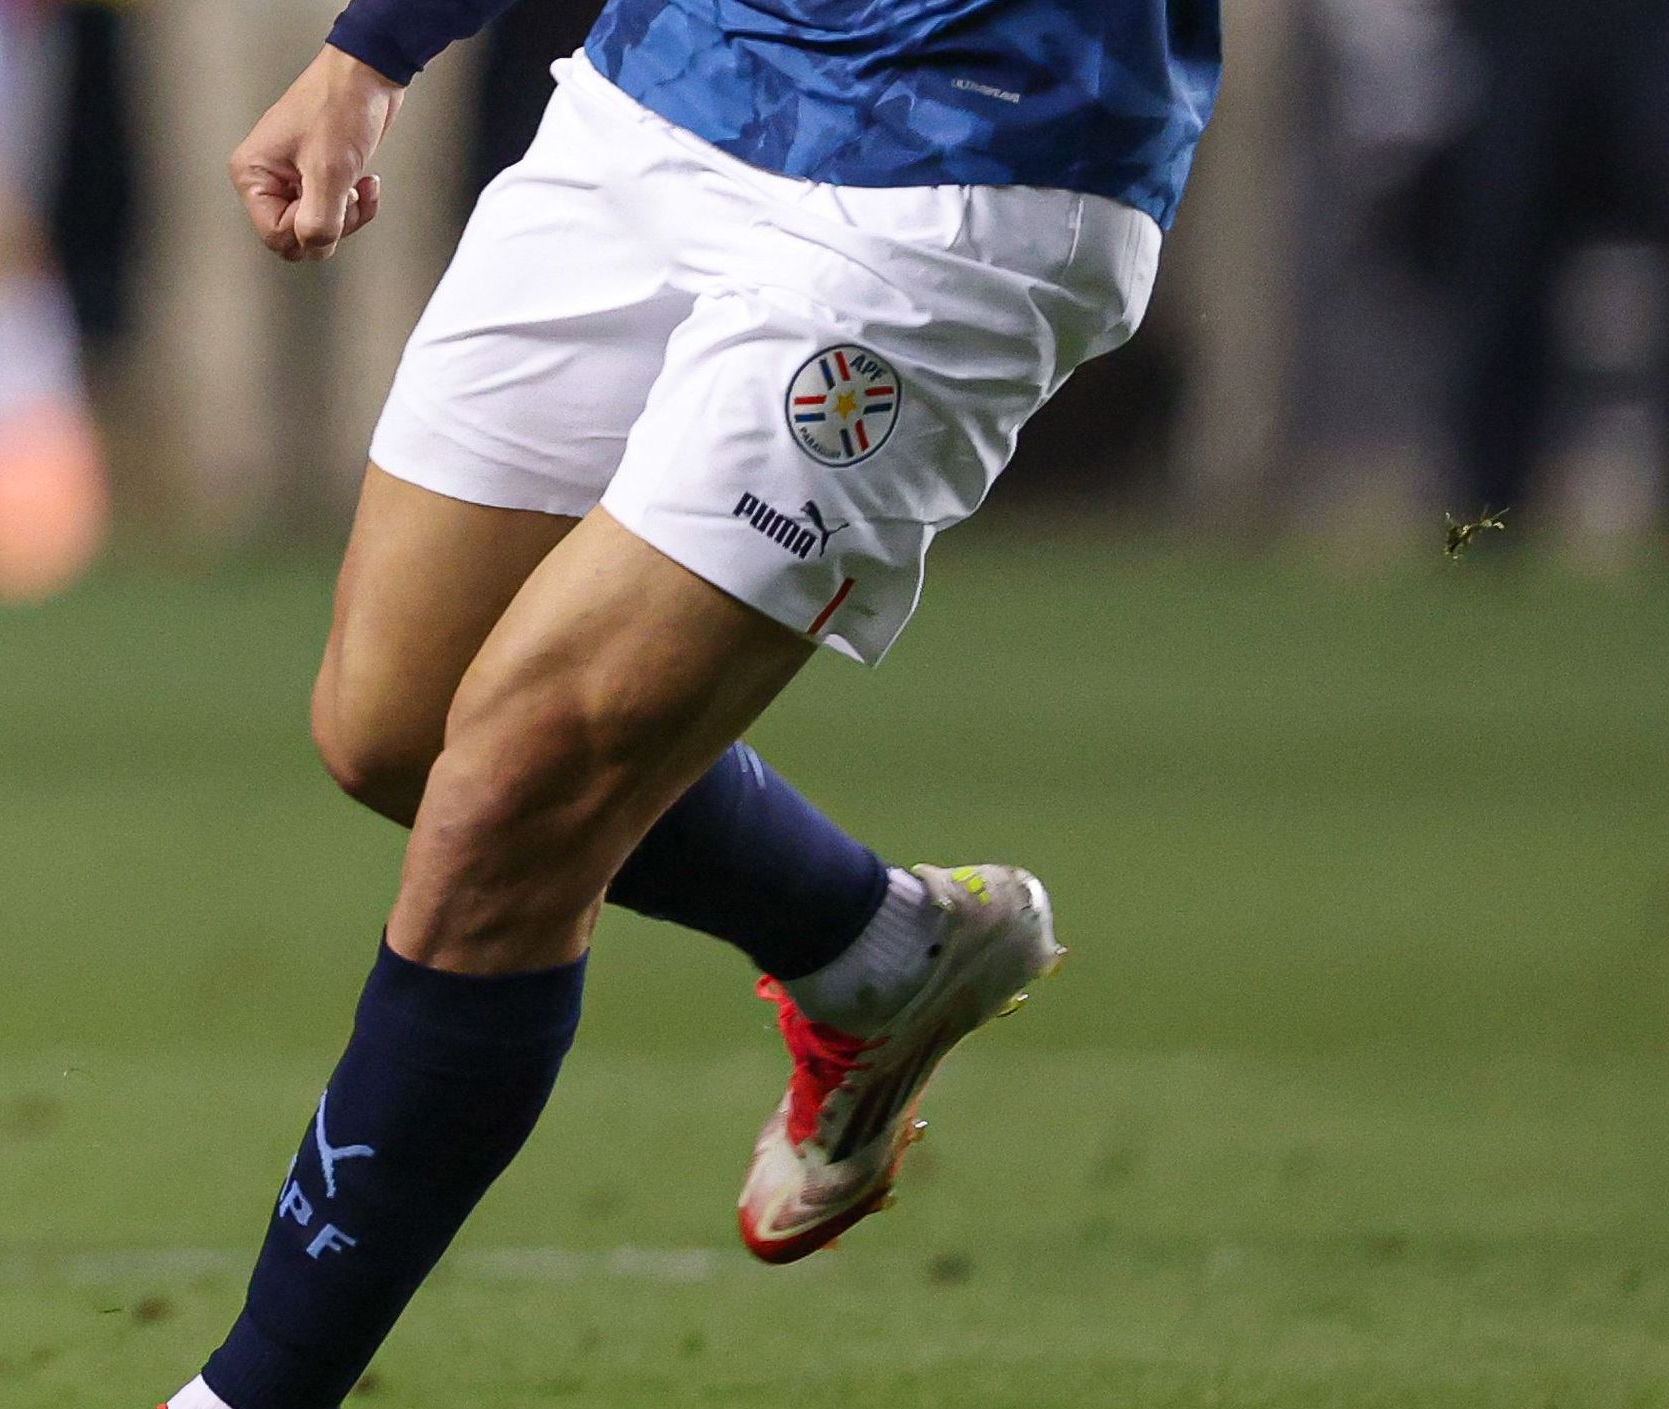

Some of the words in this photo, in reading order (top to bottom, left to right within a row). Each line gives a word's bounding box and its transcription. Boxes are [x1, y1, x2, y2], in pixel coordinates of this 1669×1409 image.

[849, 353, 887, 382] APF
[732, 491, 818, 560] PUMA
[279, 1151, 357, 1260] PF
